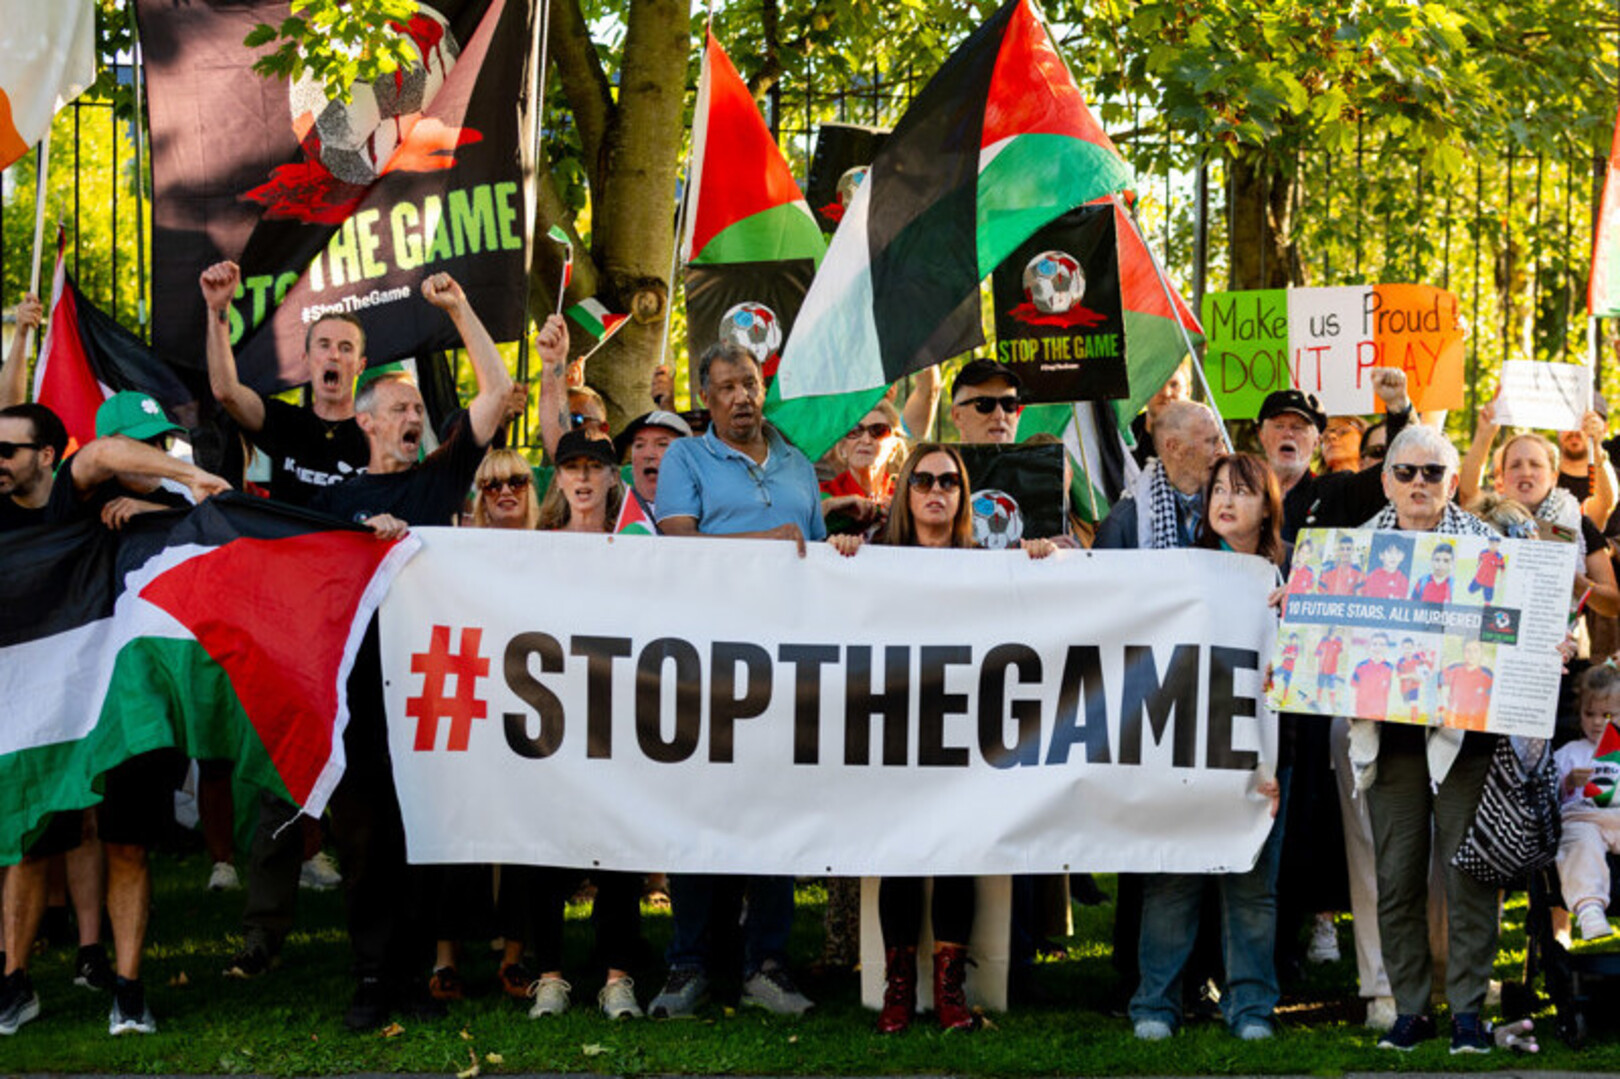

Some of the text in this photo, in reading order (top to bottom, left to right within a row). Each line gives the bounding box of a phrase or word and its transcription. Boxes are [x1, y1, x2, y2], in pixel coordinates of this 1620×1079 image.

[309, 208, 387, 292] THE
[390, 181, 522, 271] GAME
[301, 285, 411, 323] #StopTheGame
[1211, 297, 1288, 342] Make
[1309, 313, 1341, 338] us
[1362, 291, 1440, 335] Proud
[999, 333, 1119, 363] STOP THE GAME
[1288, 601, 1482, 629] 10 FUTURE STARS. ALL MURDERED
[406, 624, 1260, 770] #STOPTHEGAME
